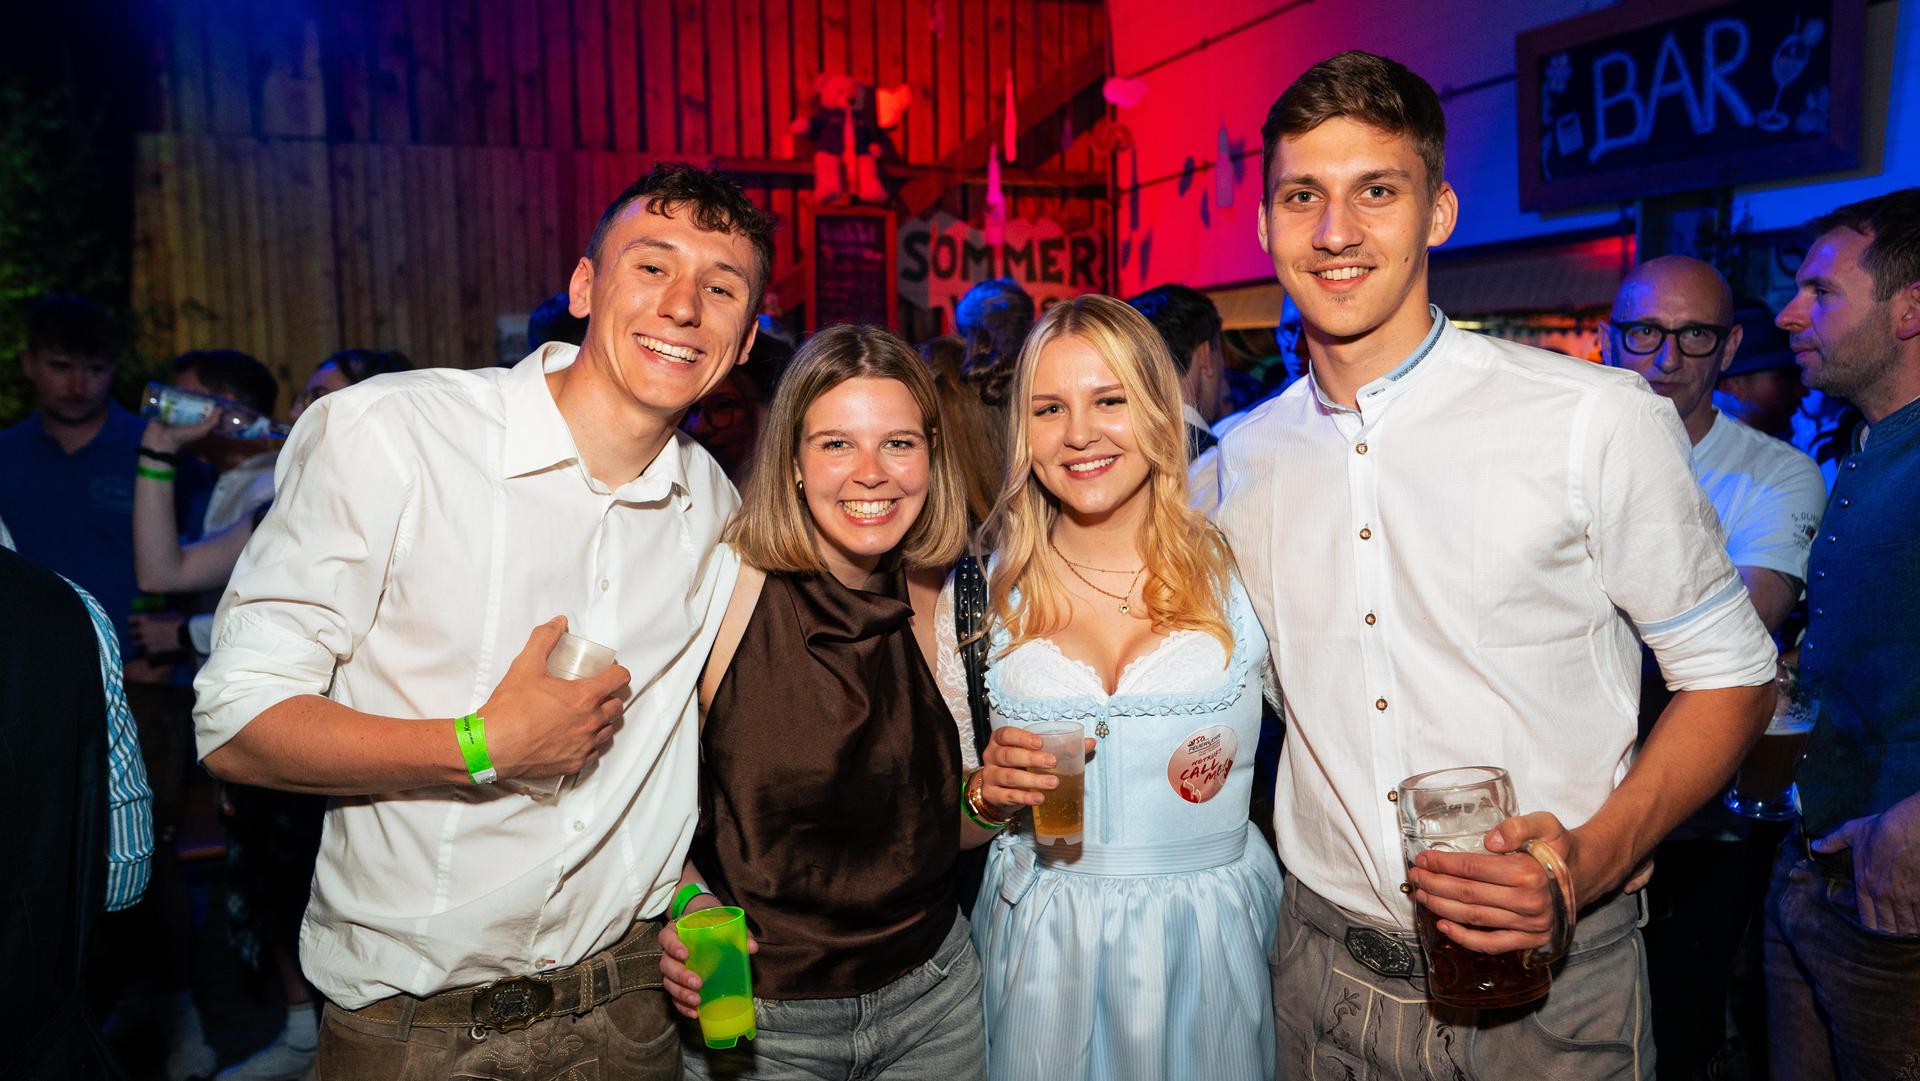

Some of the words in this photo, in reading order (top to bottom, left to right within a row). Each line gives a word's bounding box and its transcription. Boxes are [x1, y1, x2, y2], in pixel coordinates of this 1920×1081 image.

[1589, 18, 1756, 163] BAR
[901, 231, 1098, 287] SOMMER
[1180, 759, 1219, 781] CALL
